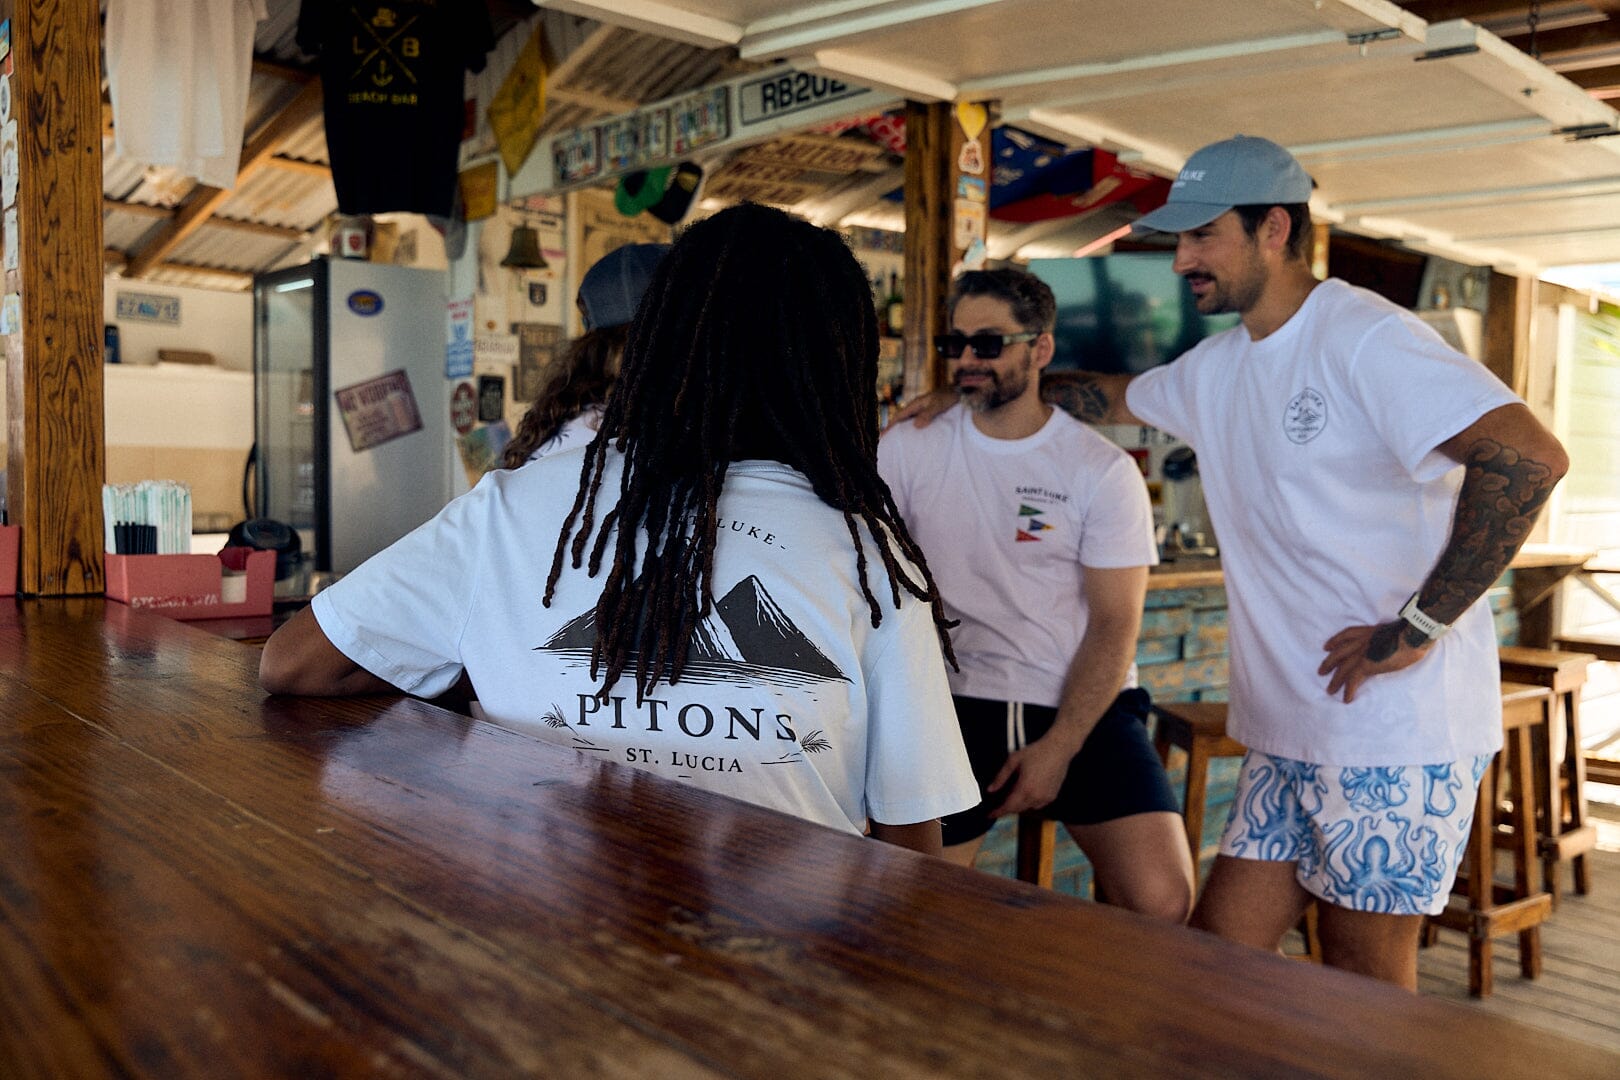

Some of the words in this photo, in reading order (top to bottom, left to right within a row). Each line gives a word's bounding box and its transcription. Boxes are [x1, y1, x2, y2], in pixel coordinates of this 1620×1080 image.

[402, 37, 420, 57] B
[1015, 486, 1043, 495] SAINT
[1043, 489, 1069, 503] LUKE
[576, 693, 797, 743] PITONS
[626, 747, 660, 765] ST.
[672, 751, 743, 773] LUCIA
